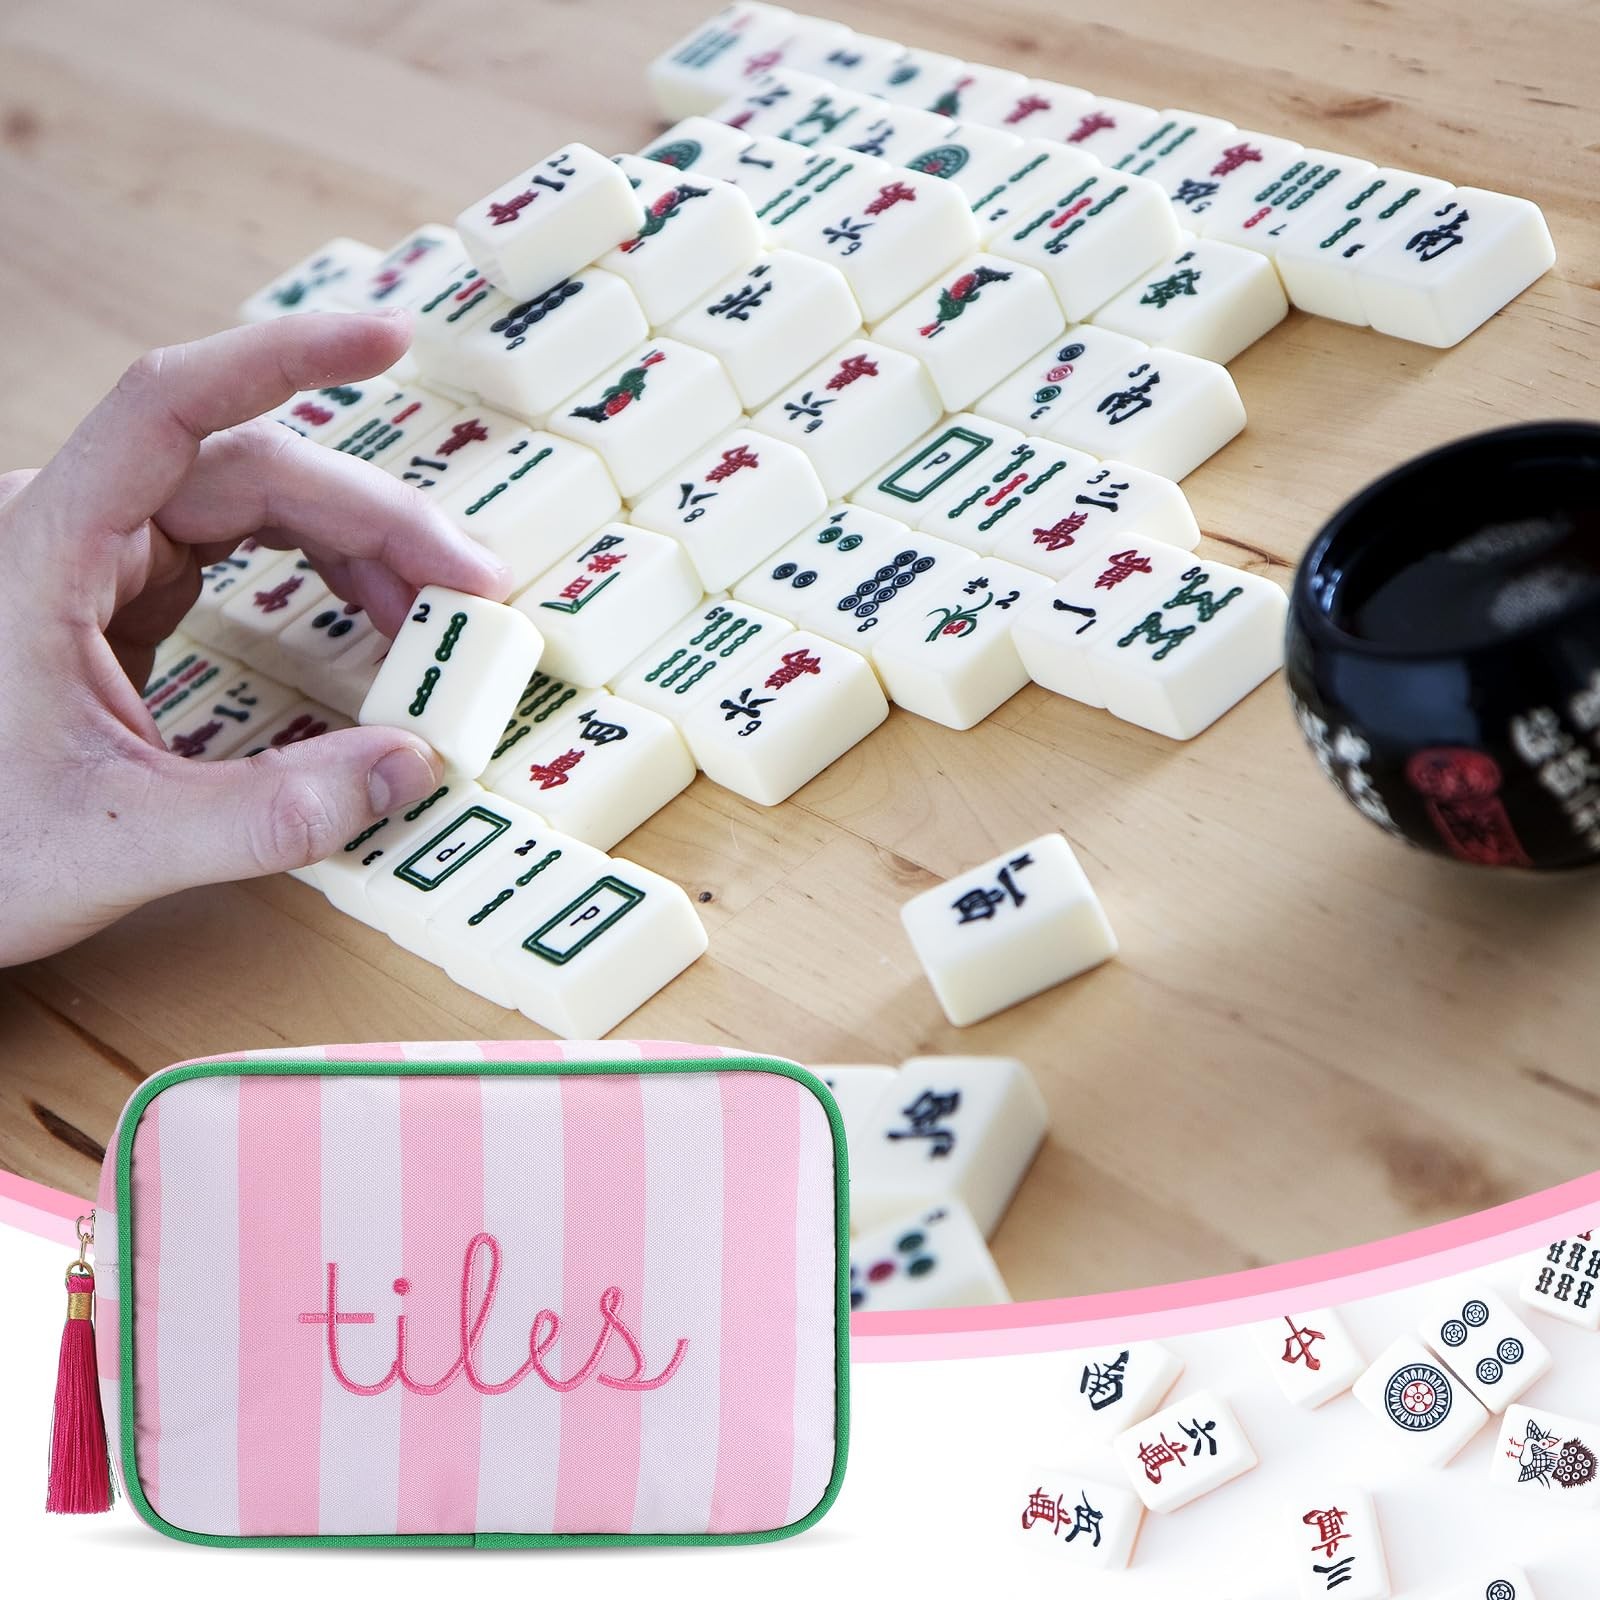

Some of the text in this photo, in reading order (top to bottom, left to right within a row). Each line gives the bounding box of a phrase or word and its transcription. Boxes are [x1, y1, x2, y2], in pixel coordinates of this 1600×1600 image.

[820, 180, 917, 245] 六萬
[1404, 208, 1470, 262] 南
[706, 281, 773, 322] 北
[783, 354, 879, 421] 六萬
[1096, 371, 1161, 426] 南
[1128, 363, 1151, 379] S
[677, 444, 759, 510] 八萬
[922, 450, 952, 471] P
[1086, 469, 1111, 485] 3
[1032, 480, 1130, 552] 三萬
[994, 590, 1021, 610] 2
[1180, 566, 1203, 582] 8
[411, 602, 431, 624] 2
[856, 617, 879, 633] 8
[719, 648, 822, 722] 六萬
[577, 709, 598, 724] 4
[528, 717, 629, 791] 四萬
[513, 839, 537, 857] 2
[296, 1230, 691, 1398] tiles
[1281, 1315, 1326, 1371] 中
[1079, 1350, 1130, 1412] 南
[1137, 1417, 1218, 1485] 六萬
[1021, 1486, 1104, 1548] 伍萬
[1302, 1506, 1356, 1591] 三萬
